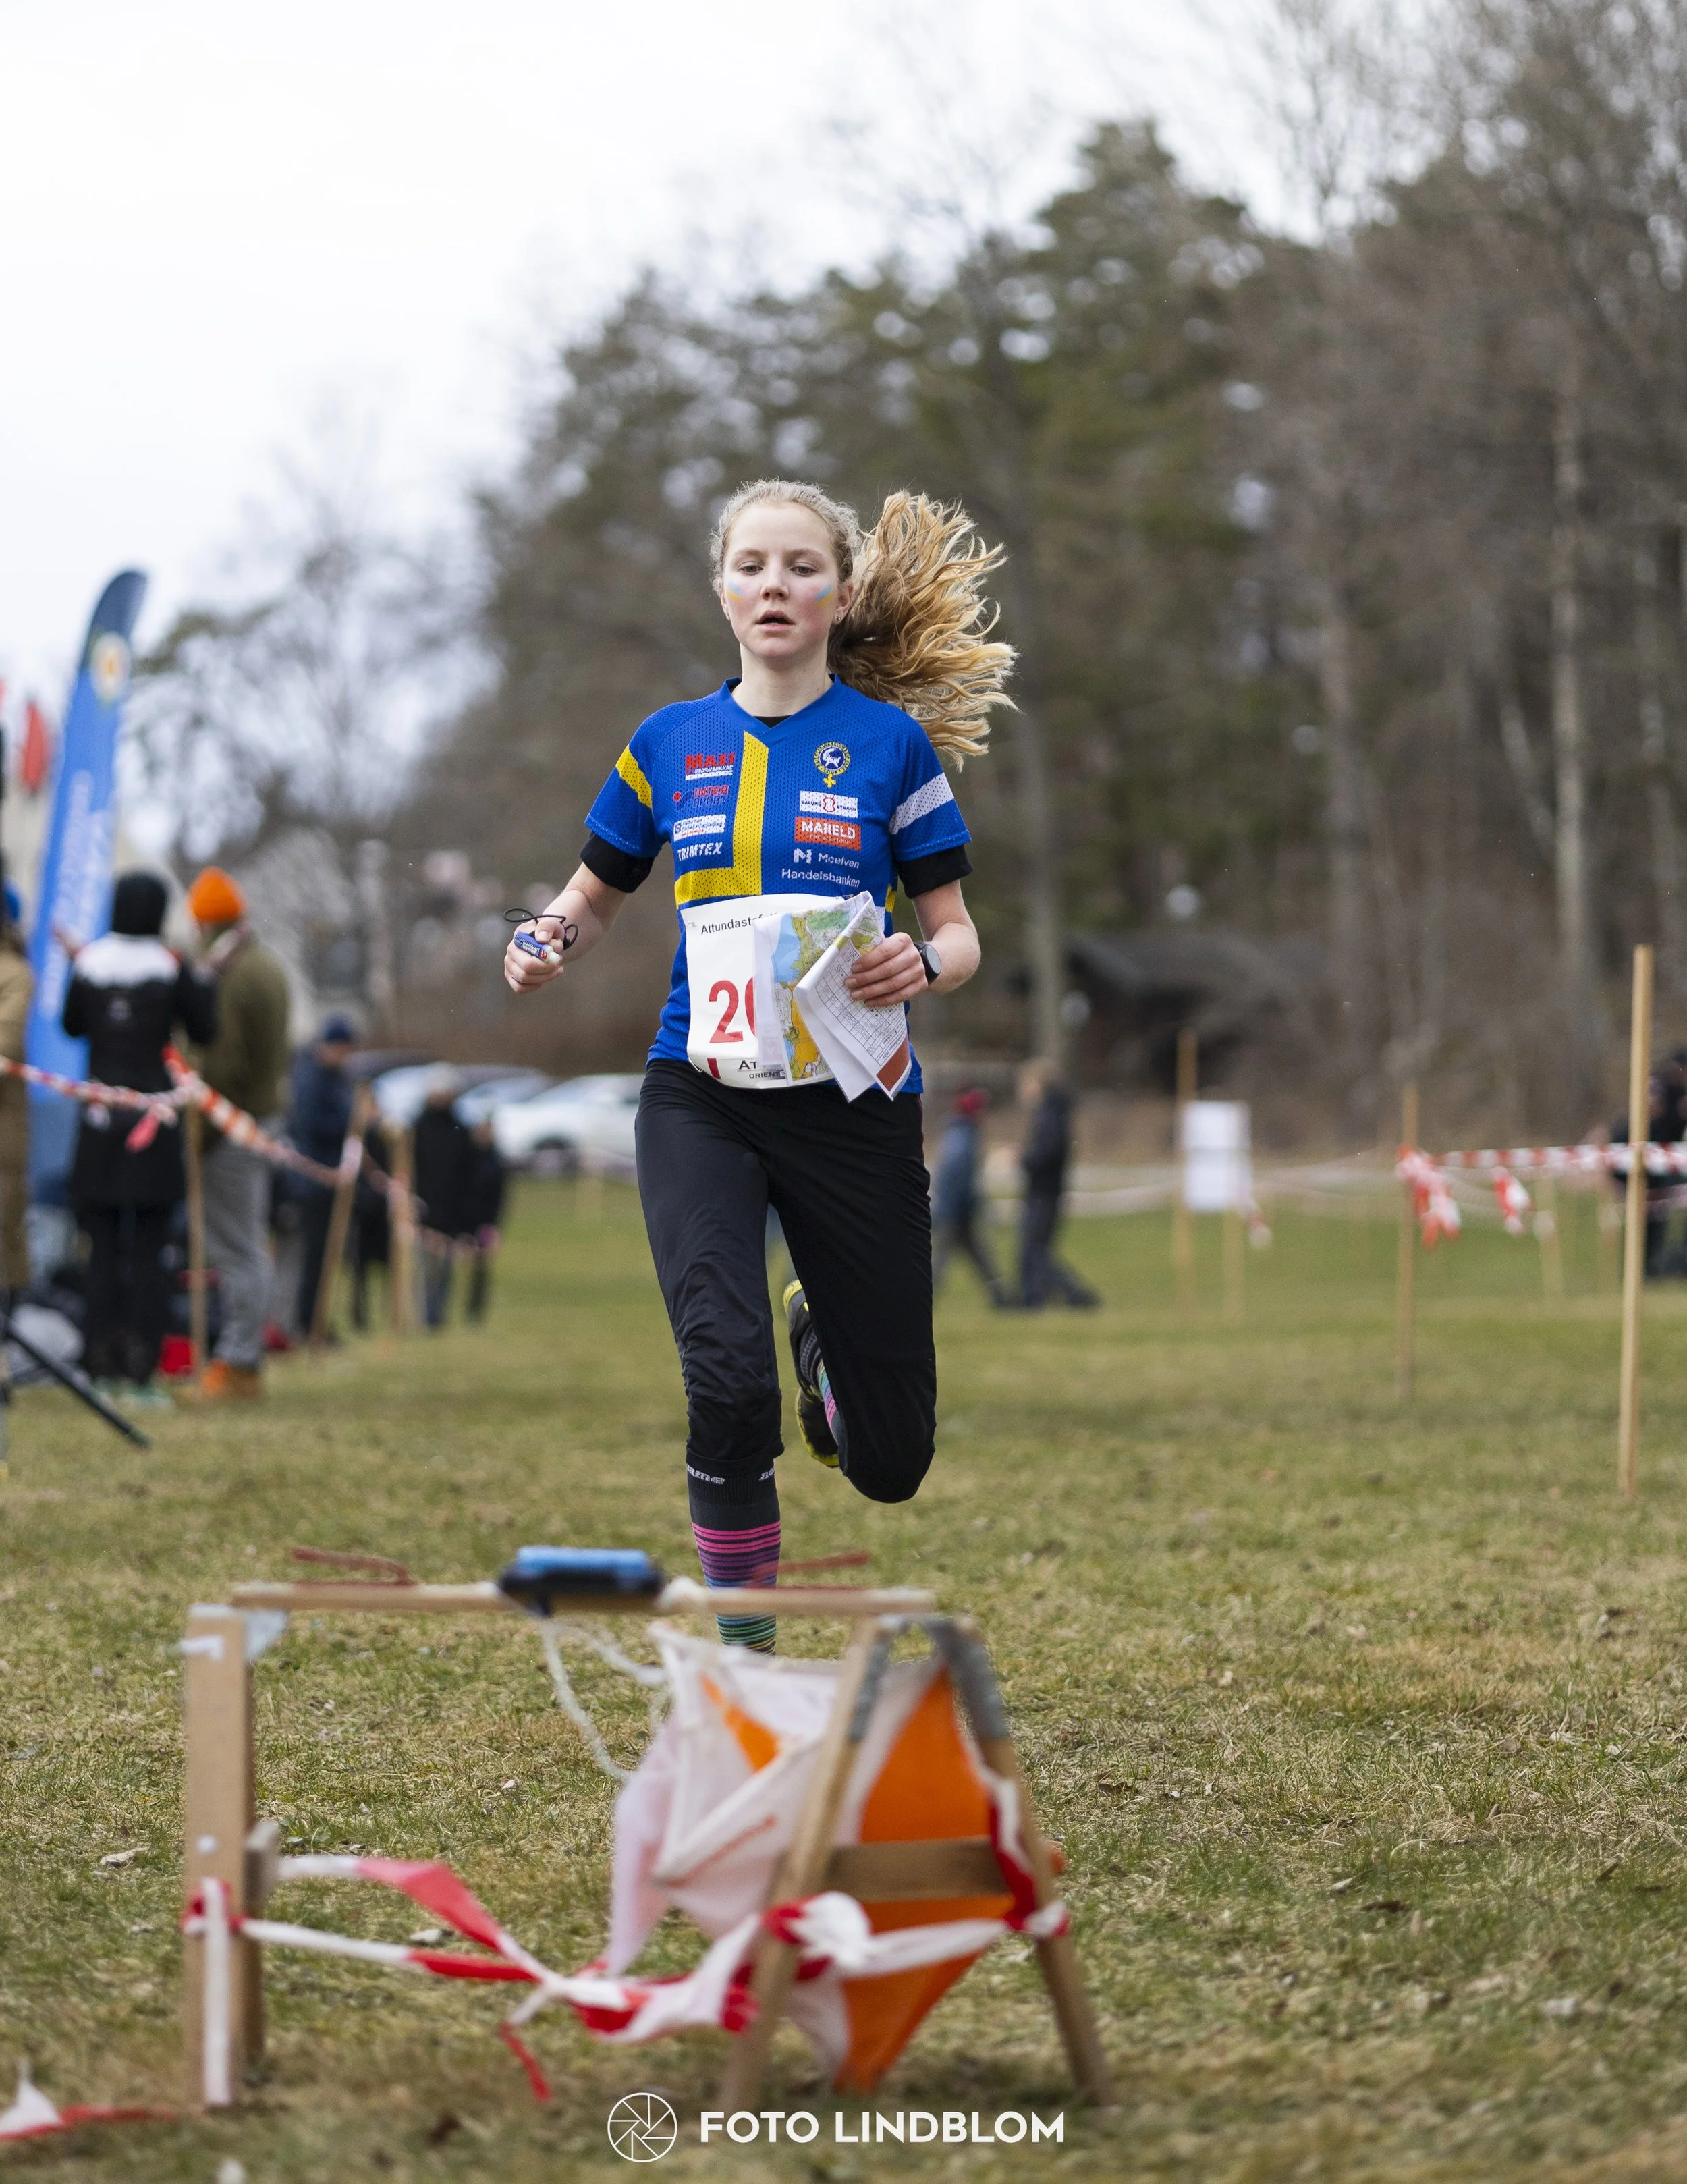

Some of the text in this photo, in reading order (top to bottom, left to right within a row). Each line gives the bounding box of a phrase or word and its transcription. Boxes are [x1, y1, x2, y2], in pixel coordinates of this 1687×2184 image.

[686, 752, 735, 770] MAXI
[694, 785, 729, 798] INTER
[693, 796, 728, 808] SPORT
[802, 821, 856, 839] MARELD
[677, 842, 723, 861] TRIMTEX
[818, 852, 860, 869] Moelven
[781, 869, 860, 888] Handelsbanken
[701, 912, 777, 935] Attundast
